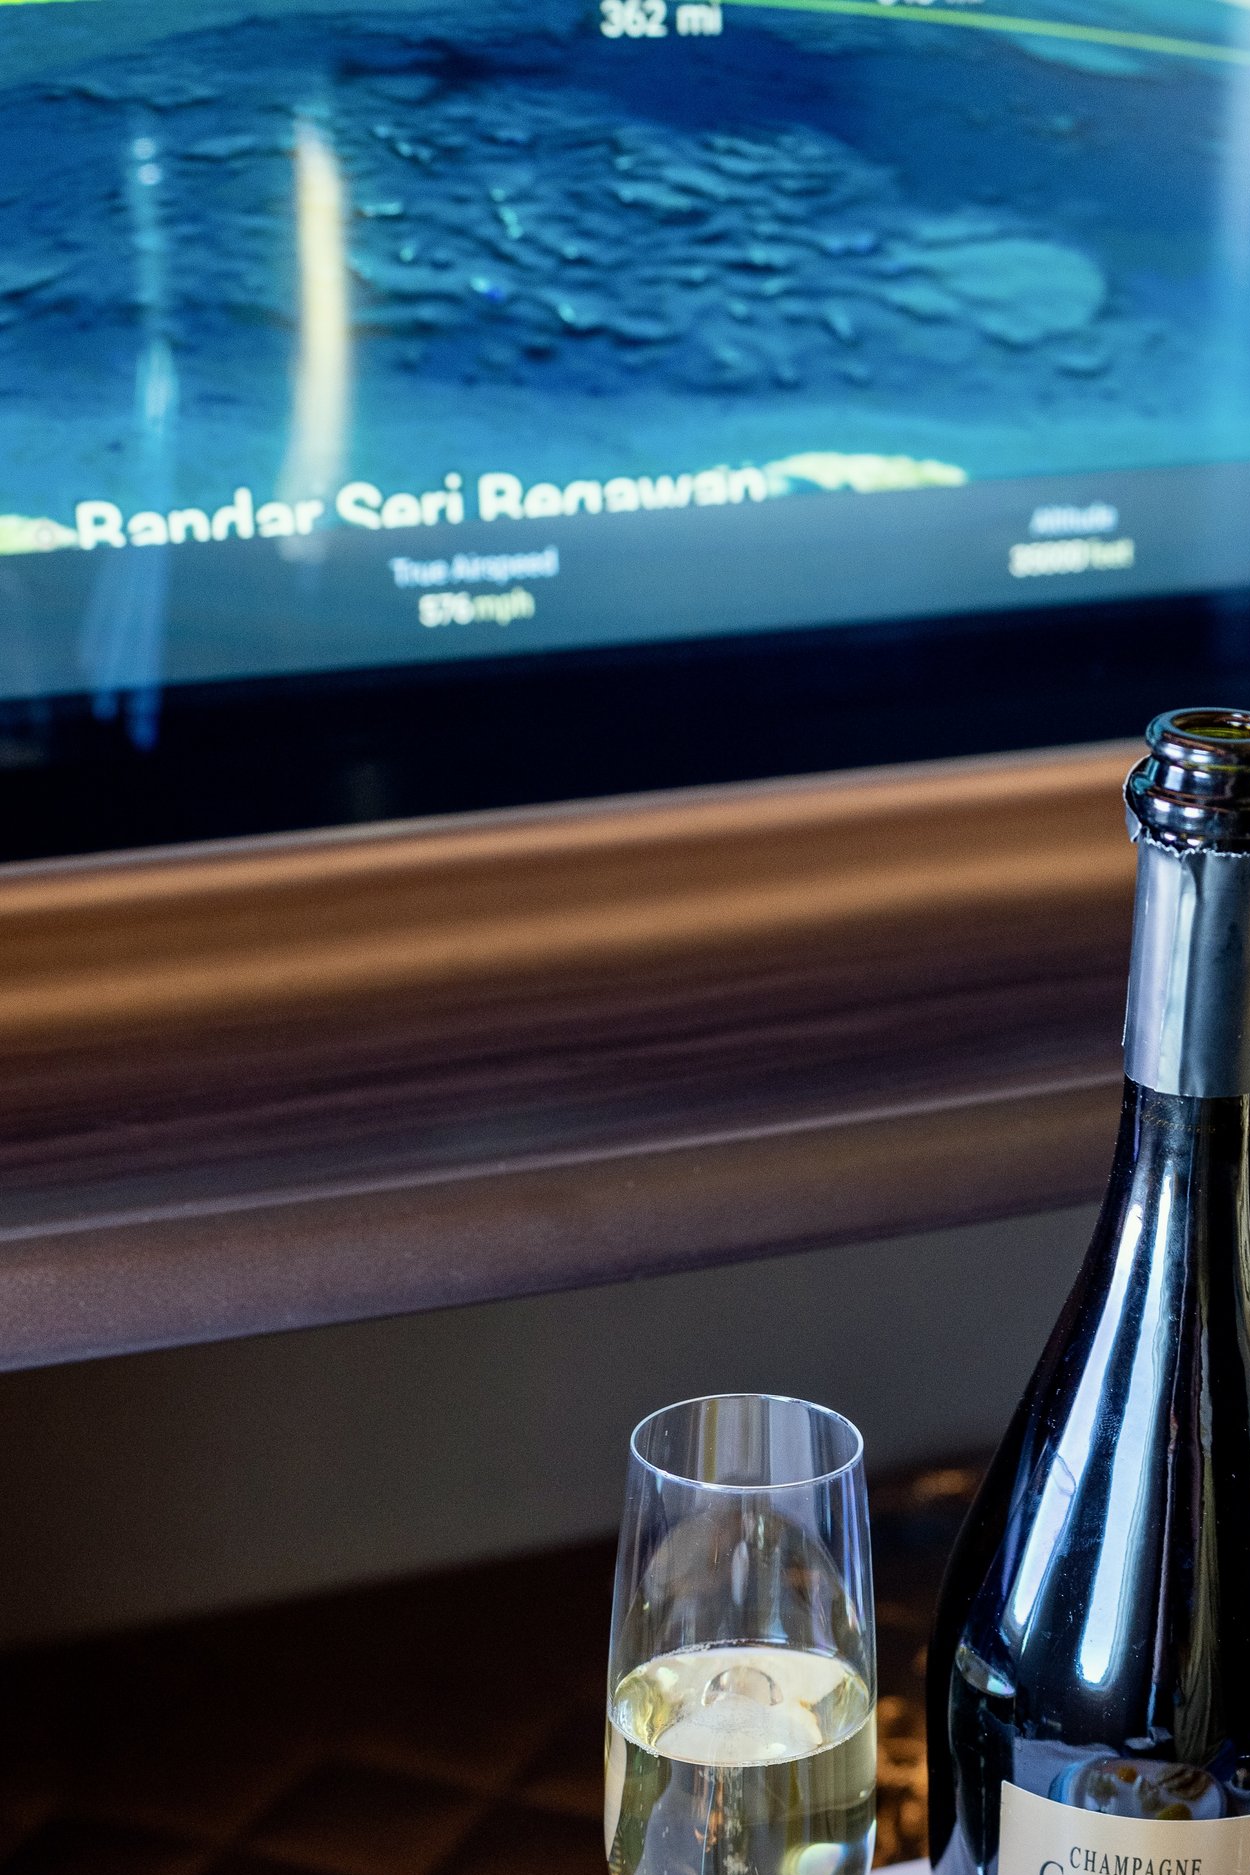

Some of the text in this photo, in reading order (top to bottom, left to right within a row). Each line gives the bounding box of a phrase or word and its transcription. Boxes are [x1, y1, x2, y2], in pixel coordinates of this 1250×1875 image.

[601, 0, 723, 38] 362 mi
[336, 472, 464, 530] Seri
